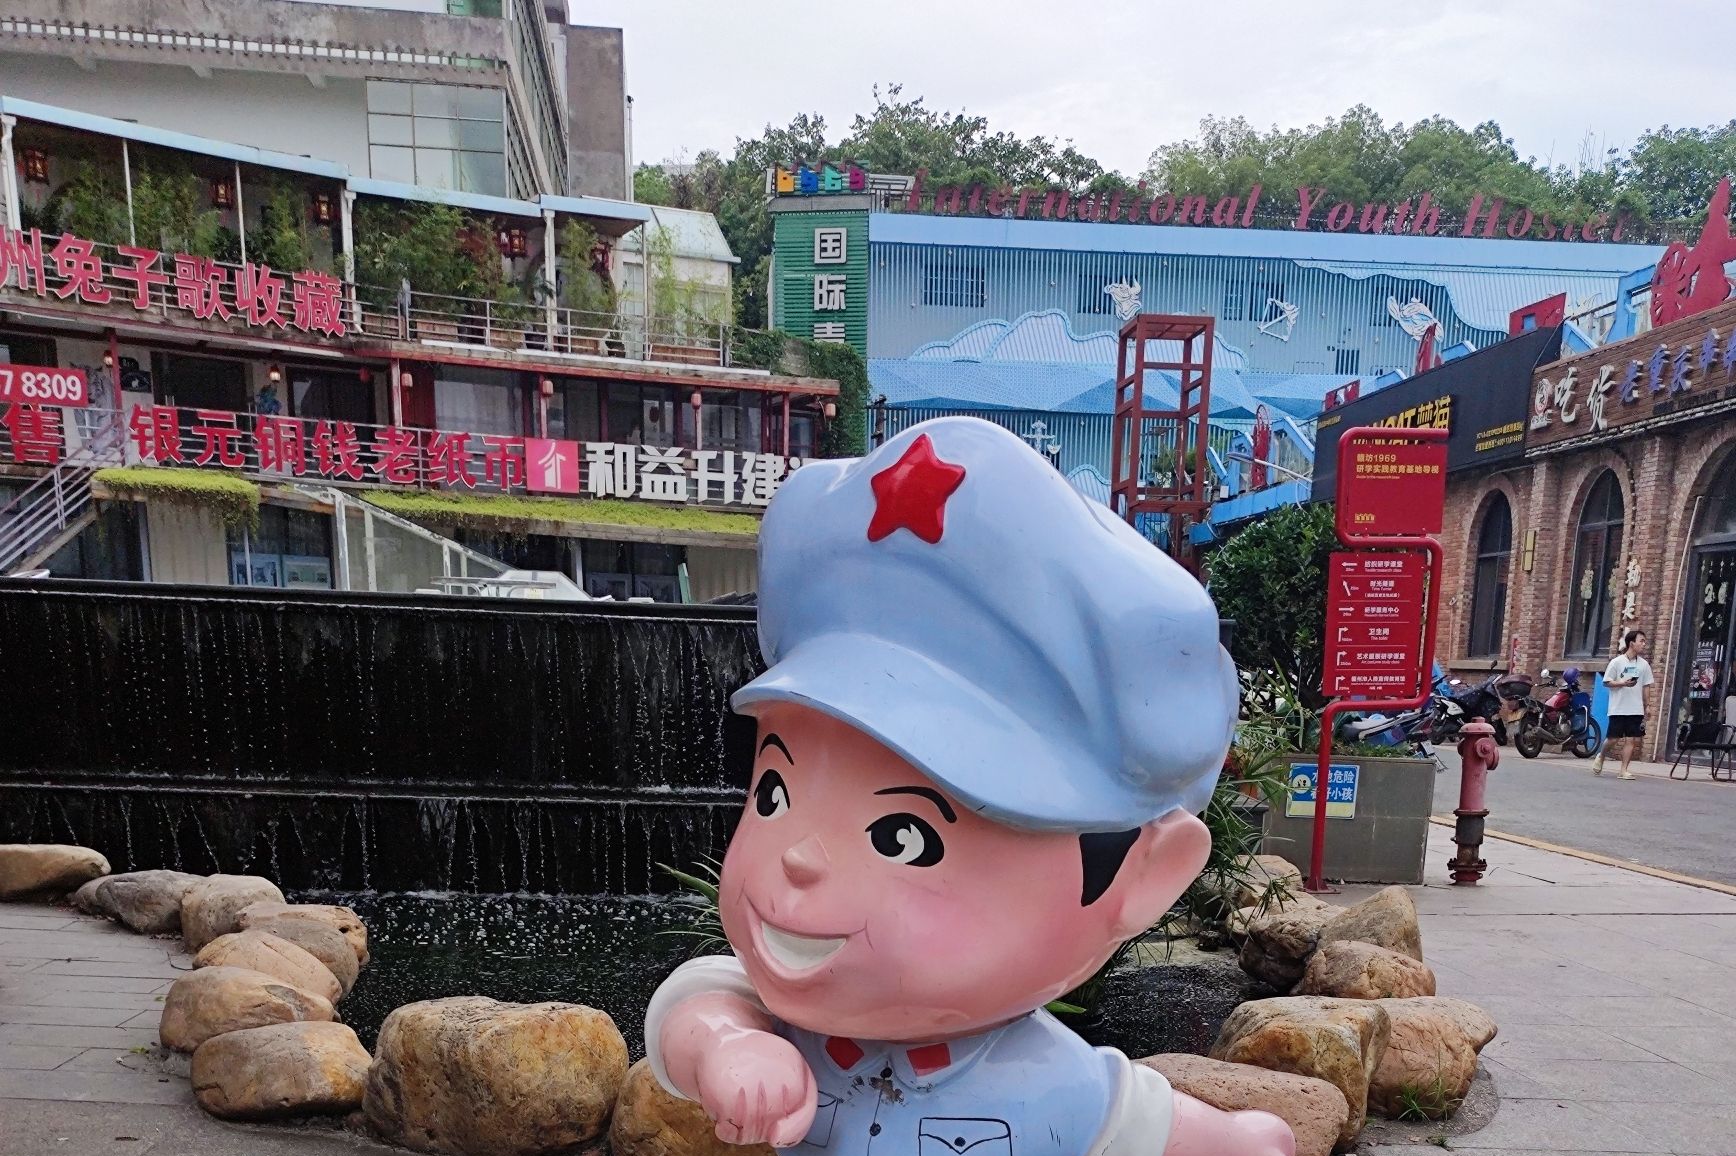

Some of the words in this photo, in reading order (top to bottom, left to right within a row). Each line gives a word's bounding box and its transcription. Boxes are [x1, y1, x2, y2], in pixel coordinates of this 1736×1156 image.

[1294, 185, 1442, 235] Youth
[0, 224, 347, 337] 州兔子歌收藏
[21, 371, 82, 401] 8309
[1, 400, 61, 465] 售
[129, 403, 526, 491] 银元铜钱老纸币
[585, 441, 832, 505] 和益升建
